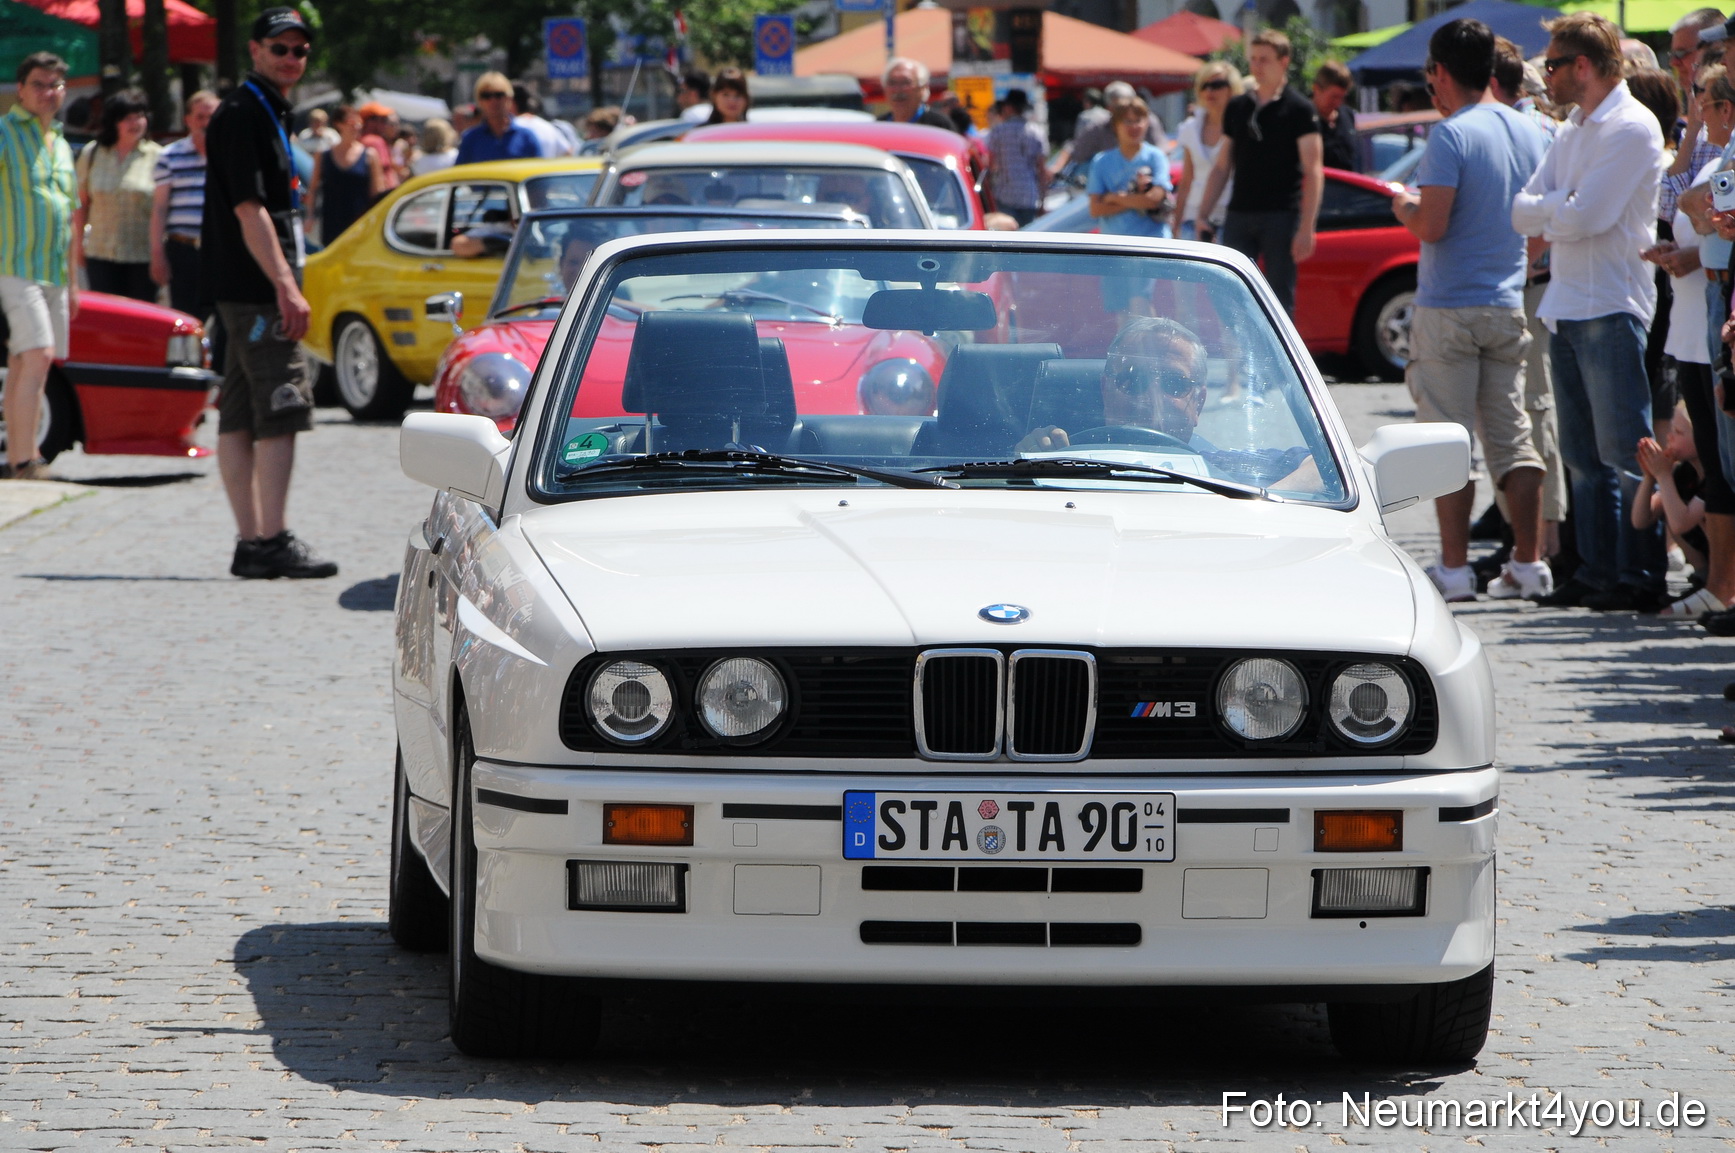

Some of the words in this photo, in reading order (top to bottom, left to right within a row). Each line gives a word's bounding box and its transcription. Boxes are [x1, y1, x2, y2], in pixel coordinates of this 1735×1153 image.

[579, 434, 593, 449] 4
[1149, 701, 1196, 718] M3
[1144, 801, 1165, 817] 04
[878, 799, 969, 852] STA
[1007, 801, 1066, 852] TA
[1079, 801, 1138, 853] 90
[854, 831, 866, 847] D
[1145, 837, 1165, 853] 10
